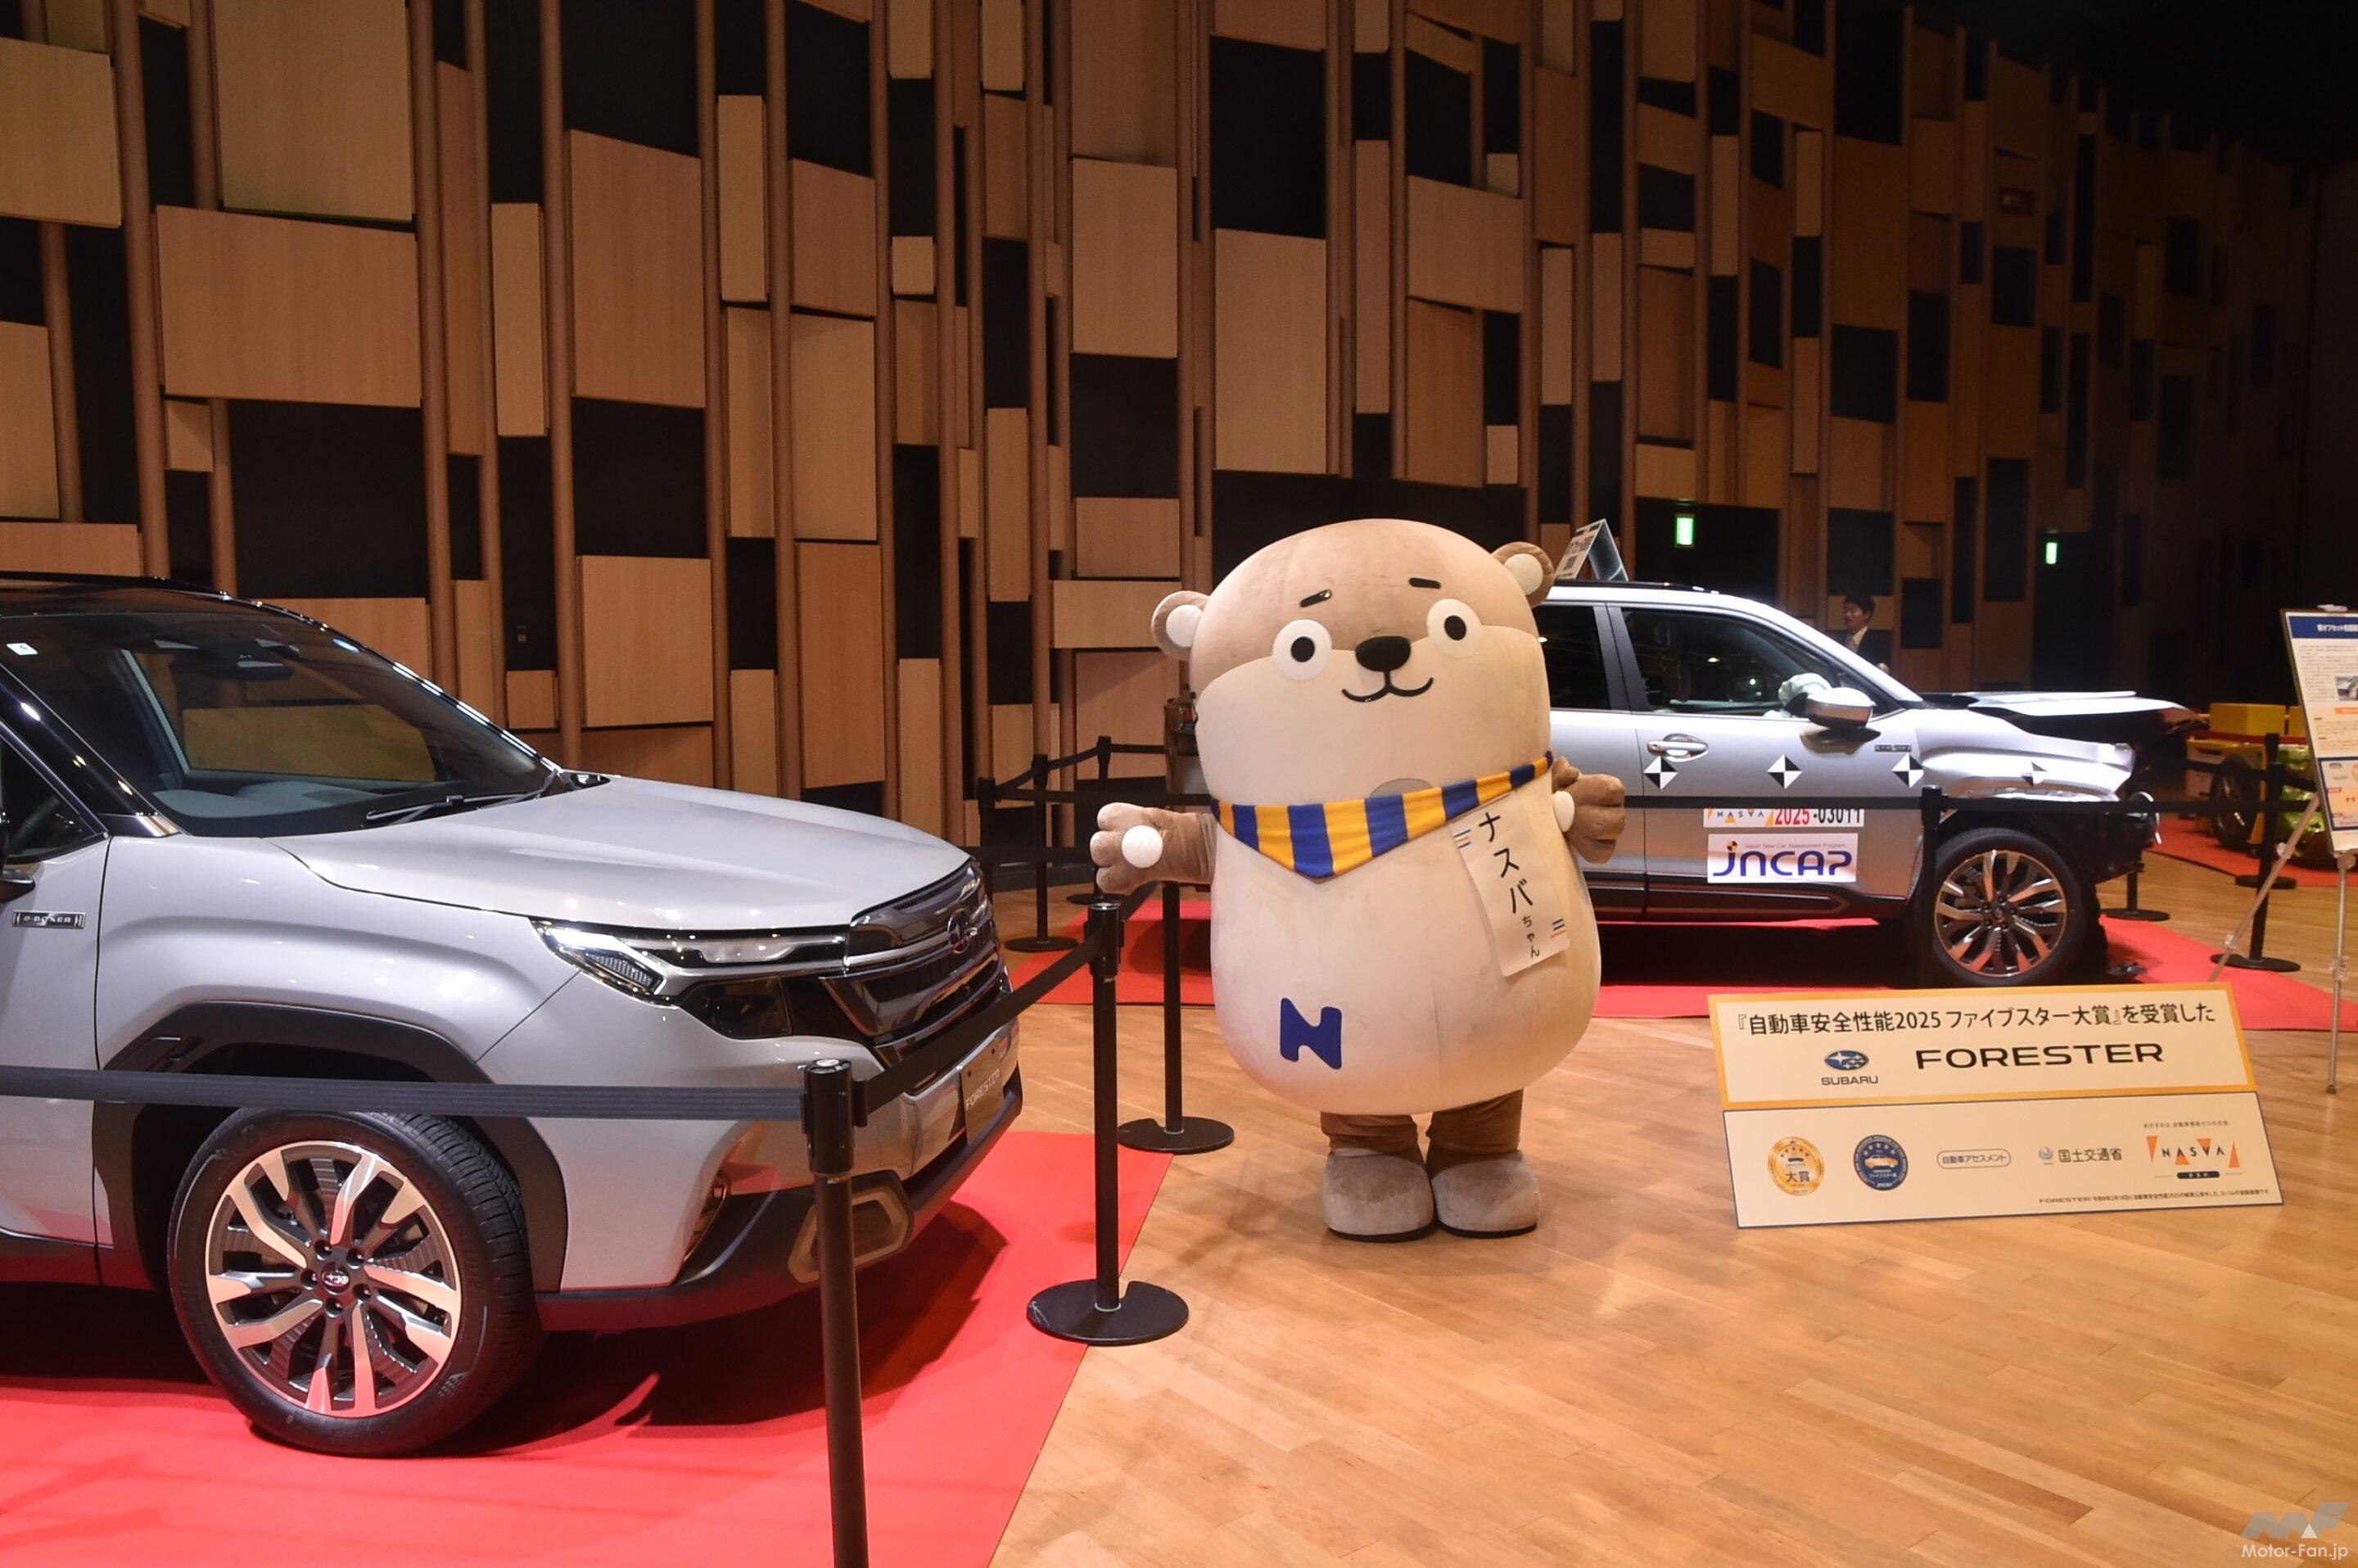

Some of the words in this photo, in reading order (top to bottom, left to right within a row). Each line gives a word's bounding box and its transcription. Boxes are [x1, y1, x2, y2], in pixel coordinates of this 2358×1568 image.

[1479, 812, 1540, 959] ナスバちゃん
[1280, 997, 1342, 1069] N
[1916, 1043, 2164, 1070] FORESTER
[965, 1068, 1001, 1111] FORESTER
[1821, 1075, 1879, 1086] SUBARU
[1942, 1154, 2007, 1164] 自動車アセスメント
[2058, 1146, 2123, 1164] 国土交通省
[1786, 1170, 1810, 1183] 大賞
